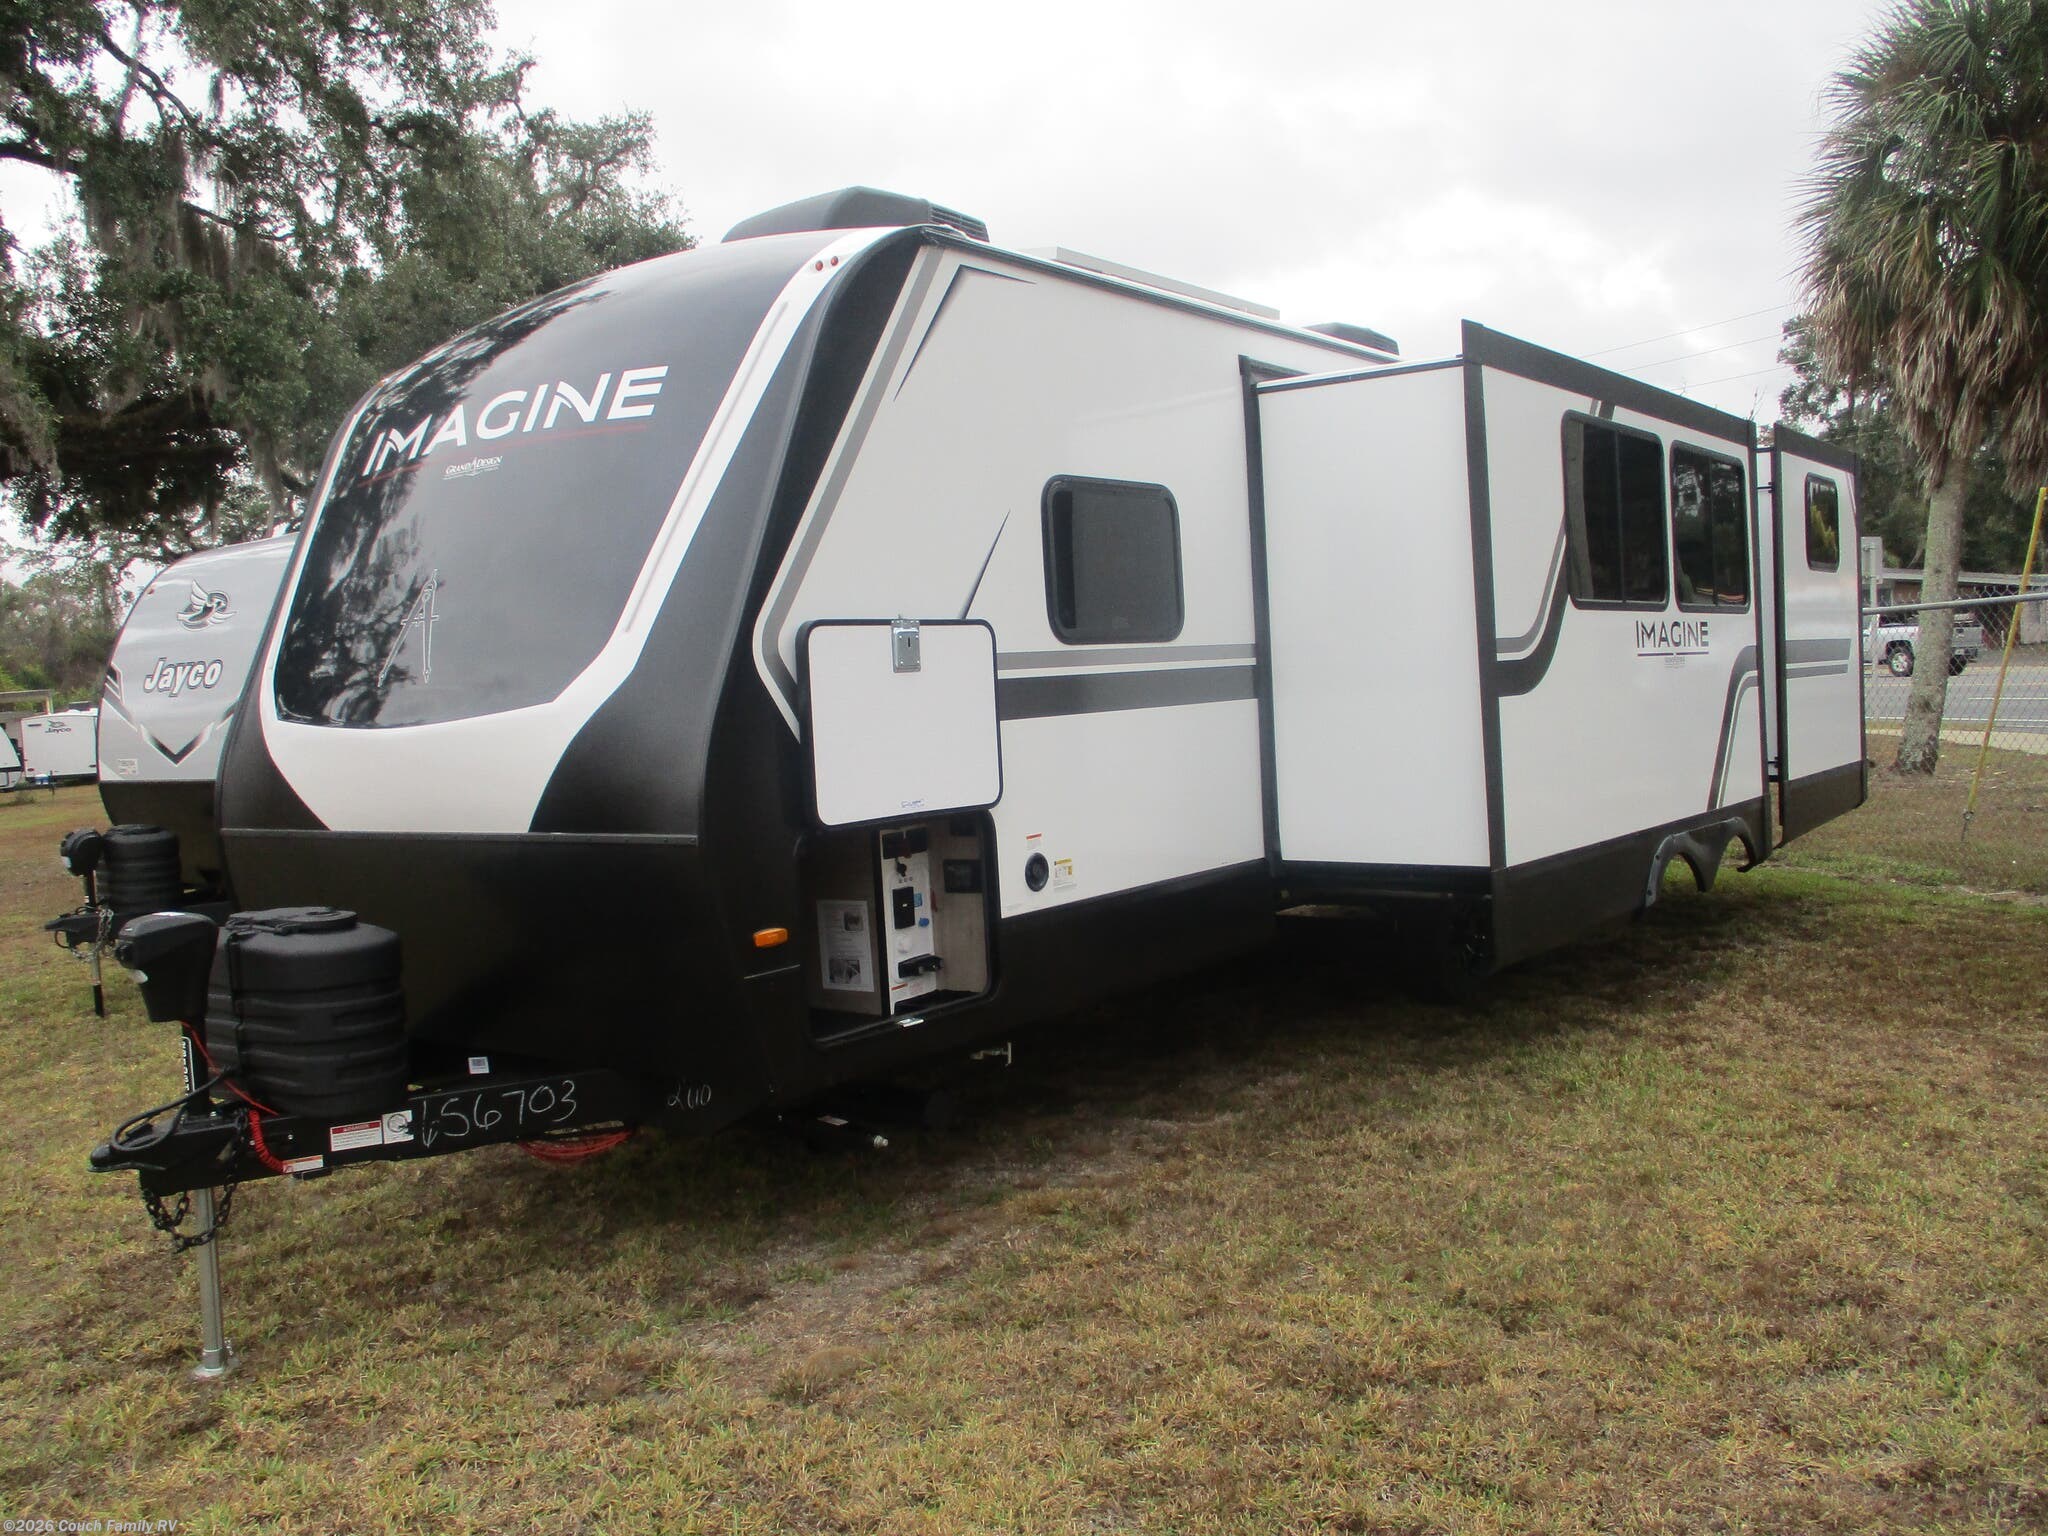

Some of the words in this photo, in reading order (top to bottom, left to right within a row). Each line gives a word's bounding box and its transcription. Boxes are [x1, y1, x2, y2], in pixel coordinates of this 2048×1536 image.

[362, 365, 669, 477] IMAGINE
[1635, 619, 1710, 649] IMAGINE
[143, 657, 223, 697] Jayco
